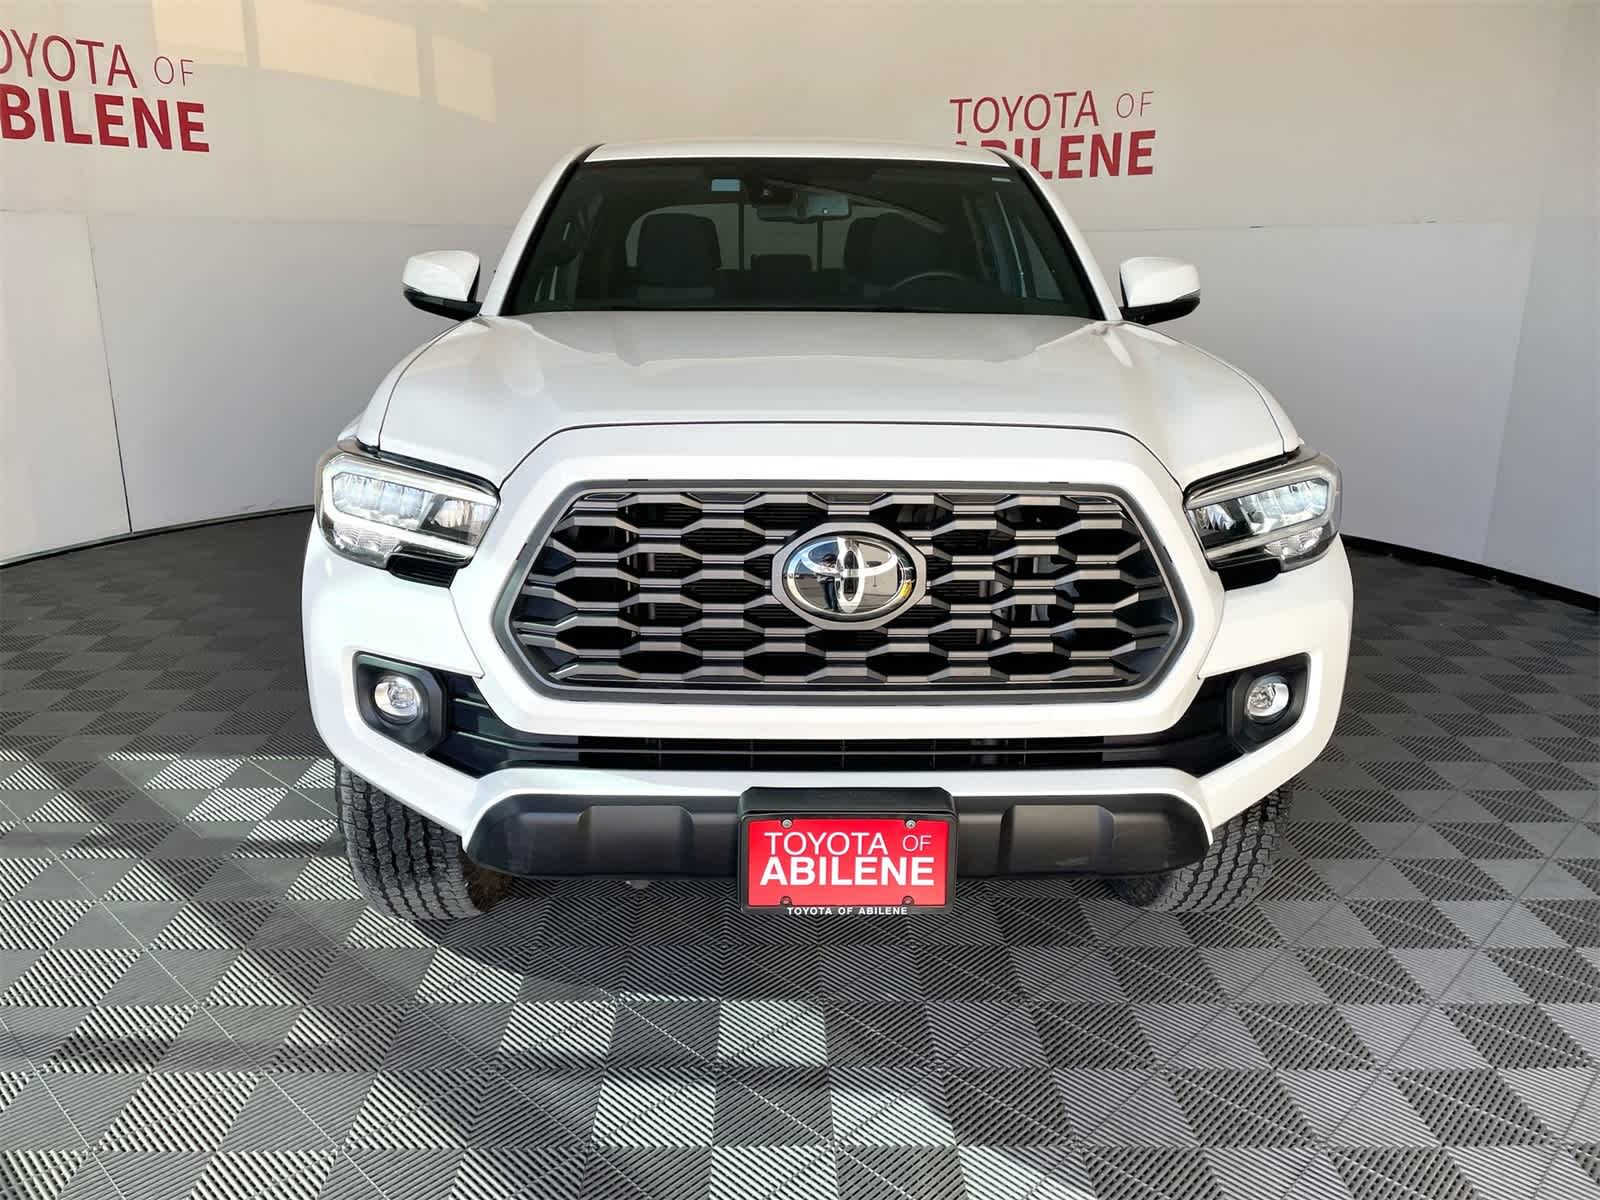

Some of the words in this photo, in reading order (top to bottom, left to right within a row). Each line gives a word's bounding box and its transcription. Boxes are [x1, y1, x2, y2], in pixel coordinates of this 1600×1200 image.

[154, 56, 193, 86] OF
[0, 83, 210, 152] BILENE
[950, 90, 1099, 134] TOYOTA
[1116, 91, 1154, 118] OF
[955, 130, 1156, 180] LENE
[764, 832, 888, 856] TOYOTA
[902, 834, 932, 852] OF
[760, 856, 935, 886] ABILENE
[787, 906, 833, 916] TOYOTA
[838, 906, 853, 916] OF
[858, 906, 908, 916] ABILENE
